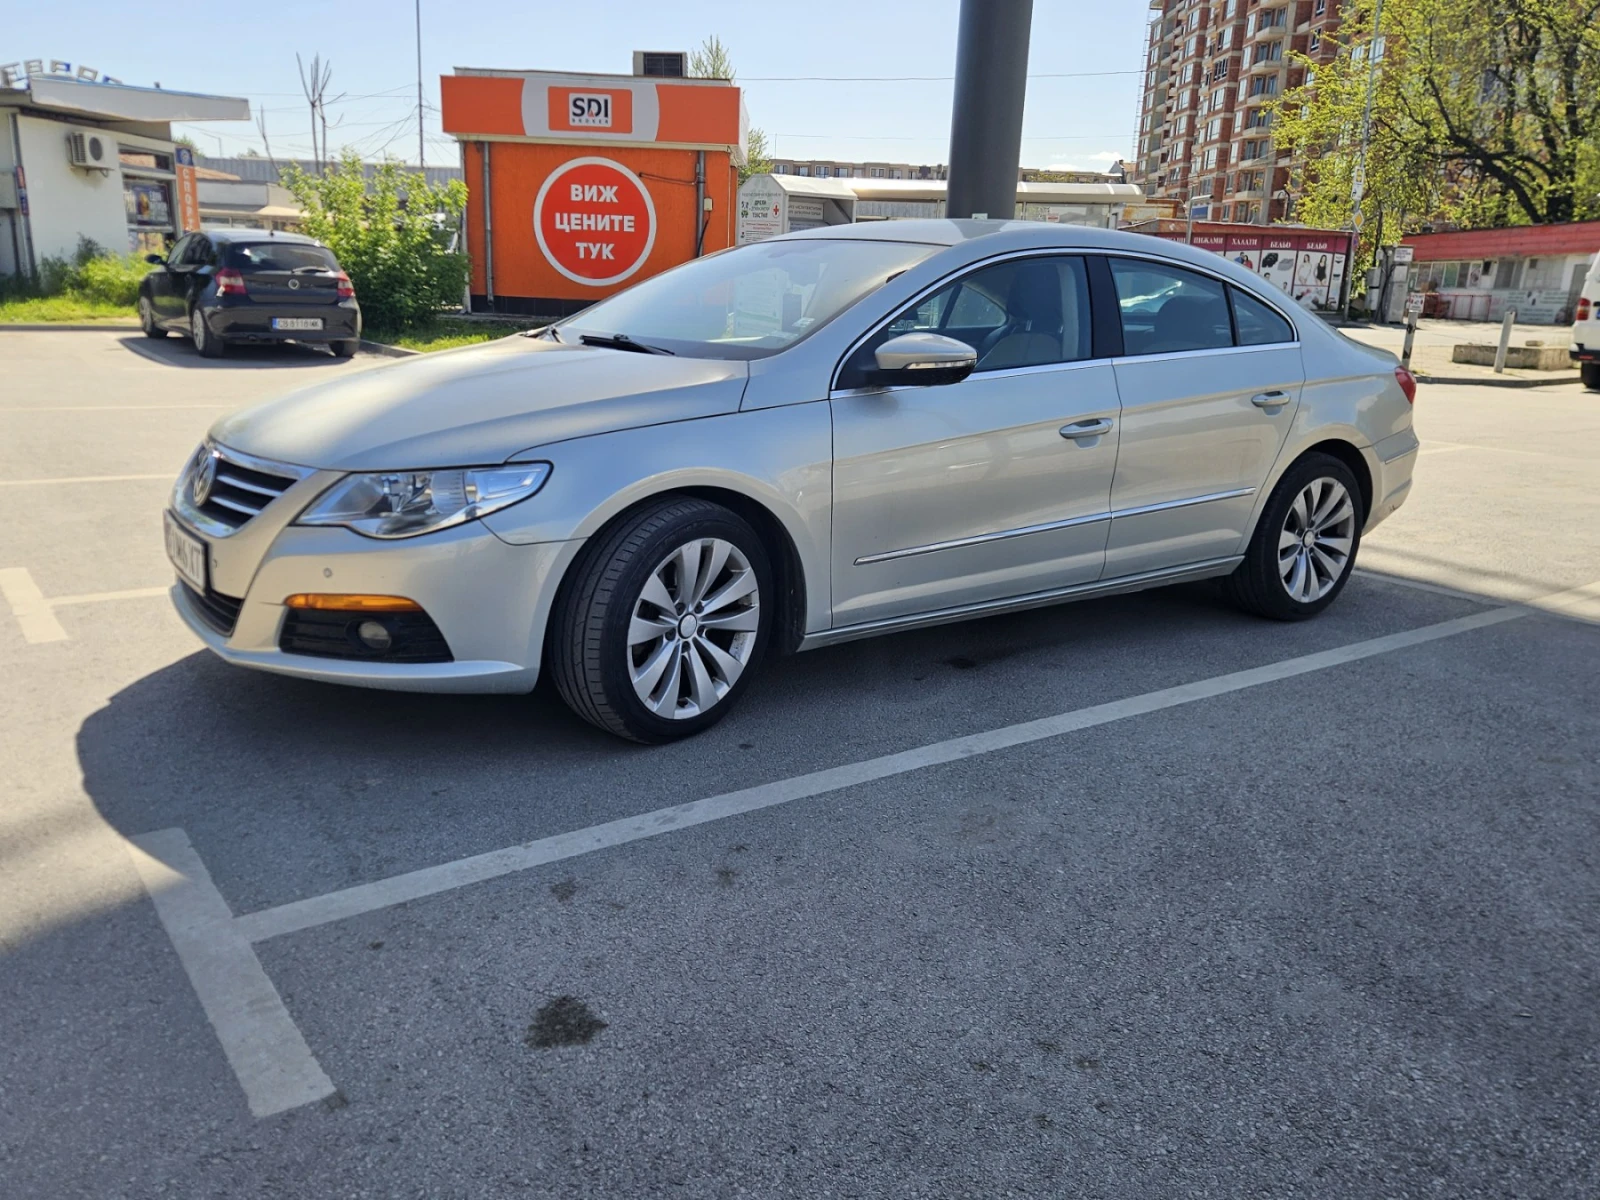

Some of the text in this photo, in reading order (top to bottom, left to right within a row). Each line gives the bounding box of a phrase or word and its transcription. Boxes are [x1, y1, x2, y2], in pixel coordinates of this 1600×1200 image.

[572, 97, 609, 118] SDI
[570, 184, 619, 203] ВИЖ
[555, 213, 635, 233] ЦЕНИТЕ
[1193, 237, 1224, 245] ПИЖАМИ
[1232, 238, 1258, 246] ХАЛАТИ
[1270, 241, 1292, 249] БЕЛЬО
[1306, 242, 1327, 250] БЕЛЬО
[575, 242, 616, 260] ТУК
